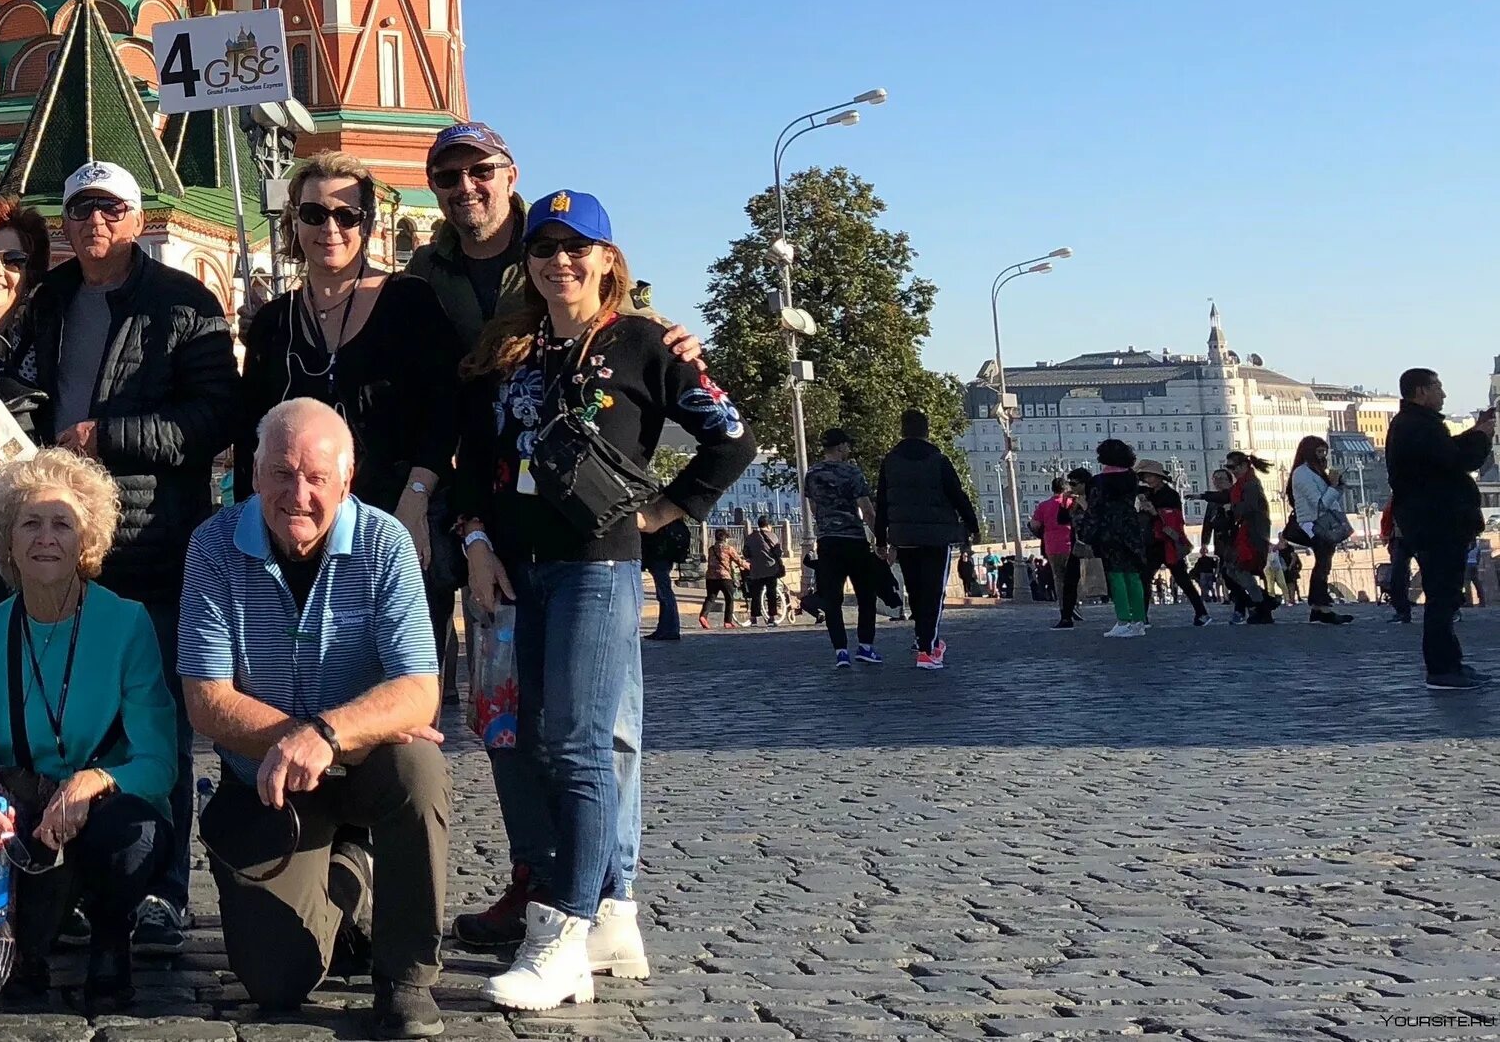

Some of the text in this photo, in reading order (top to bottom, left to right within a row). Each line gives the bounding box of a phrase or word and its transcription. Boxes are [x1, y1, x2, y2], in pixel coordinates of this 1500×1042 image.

[160, 33, 201, 98] 4
[206, 82, 284, 96] Grand Trans Siberian Express
